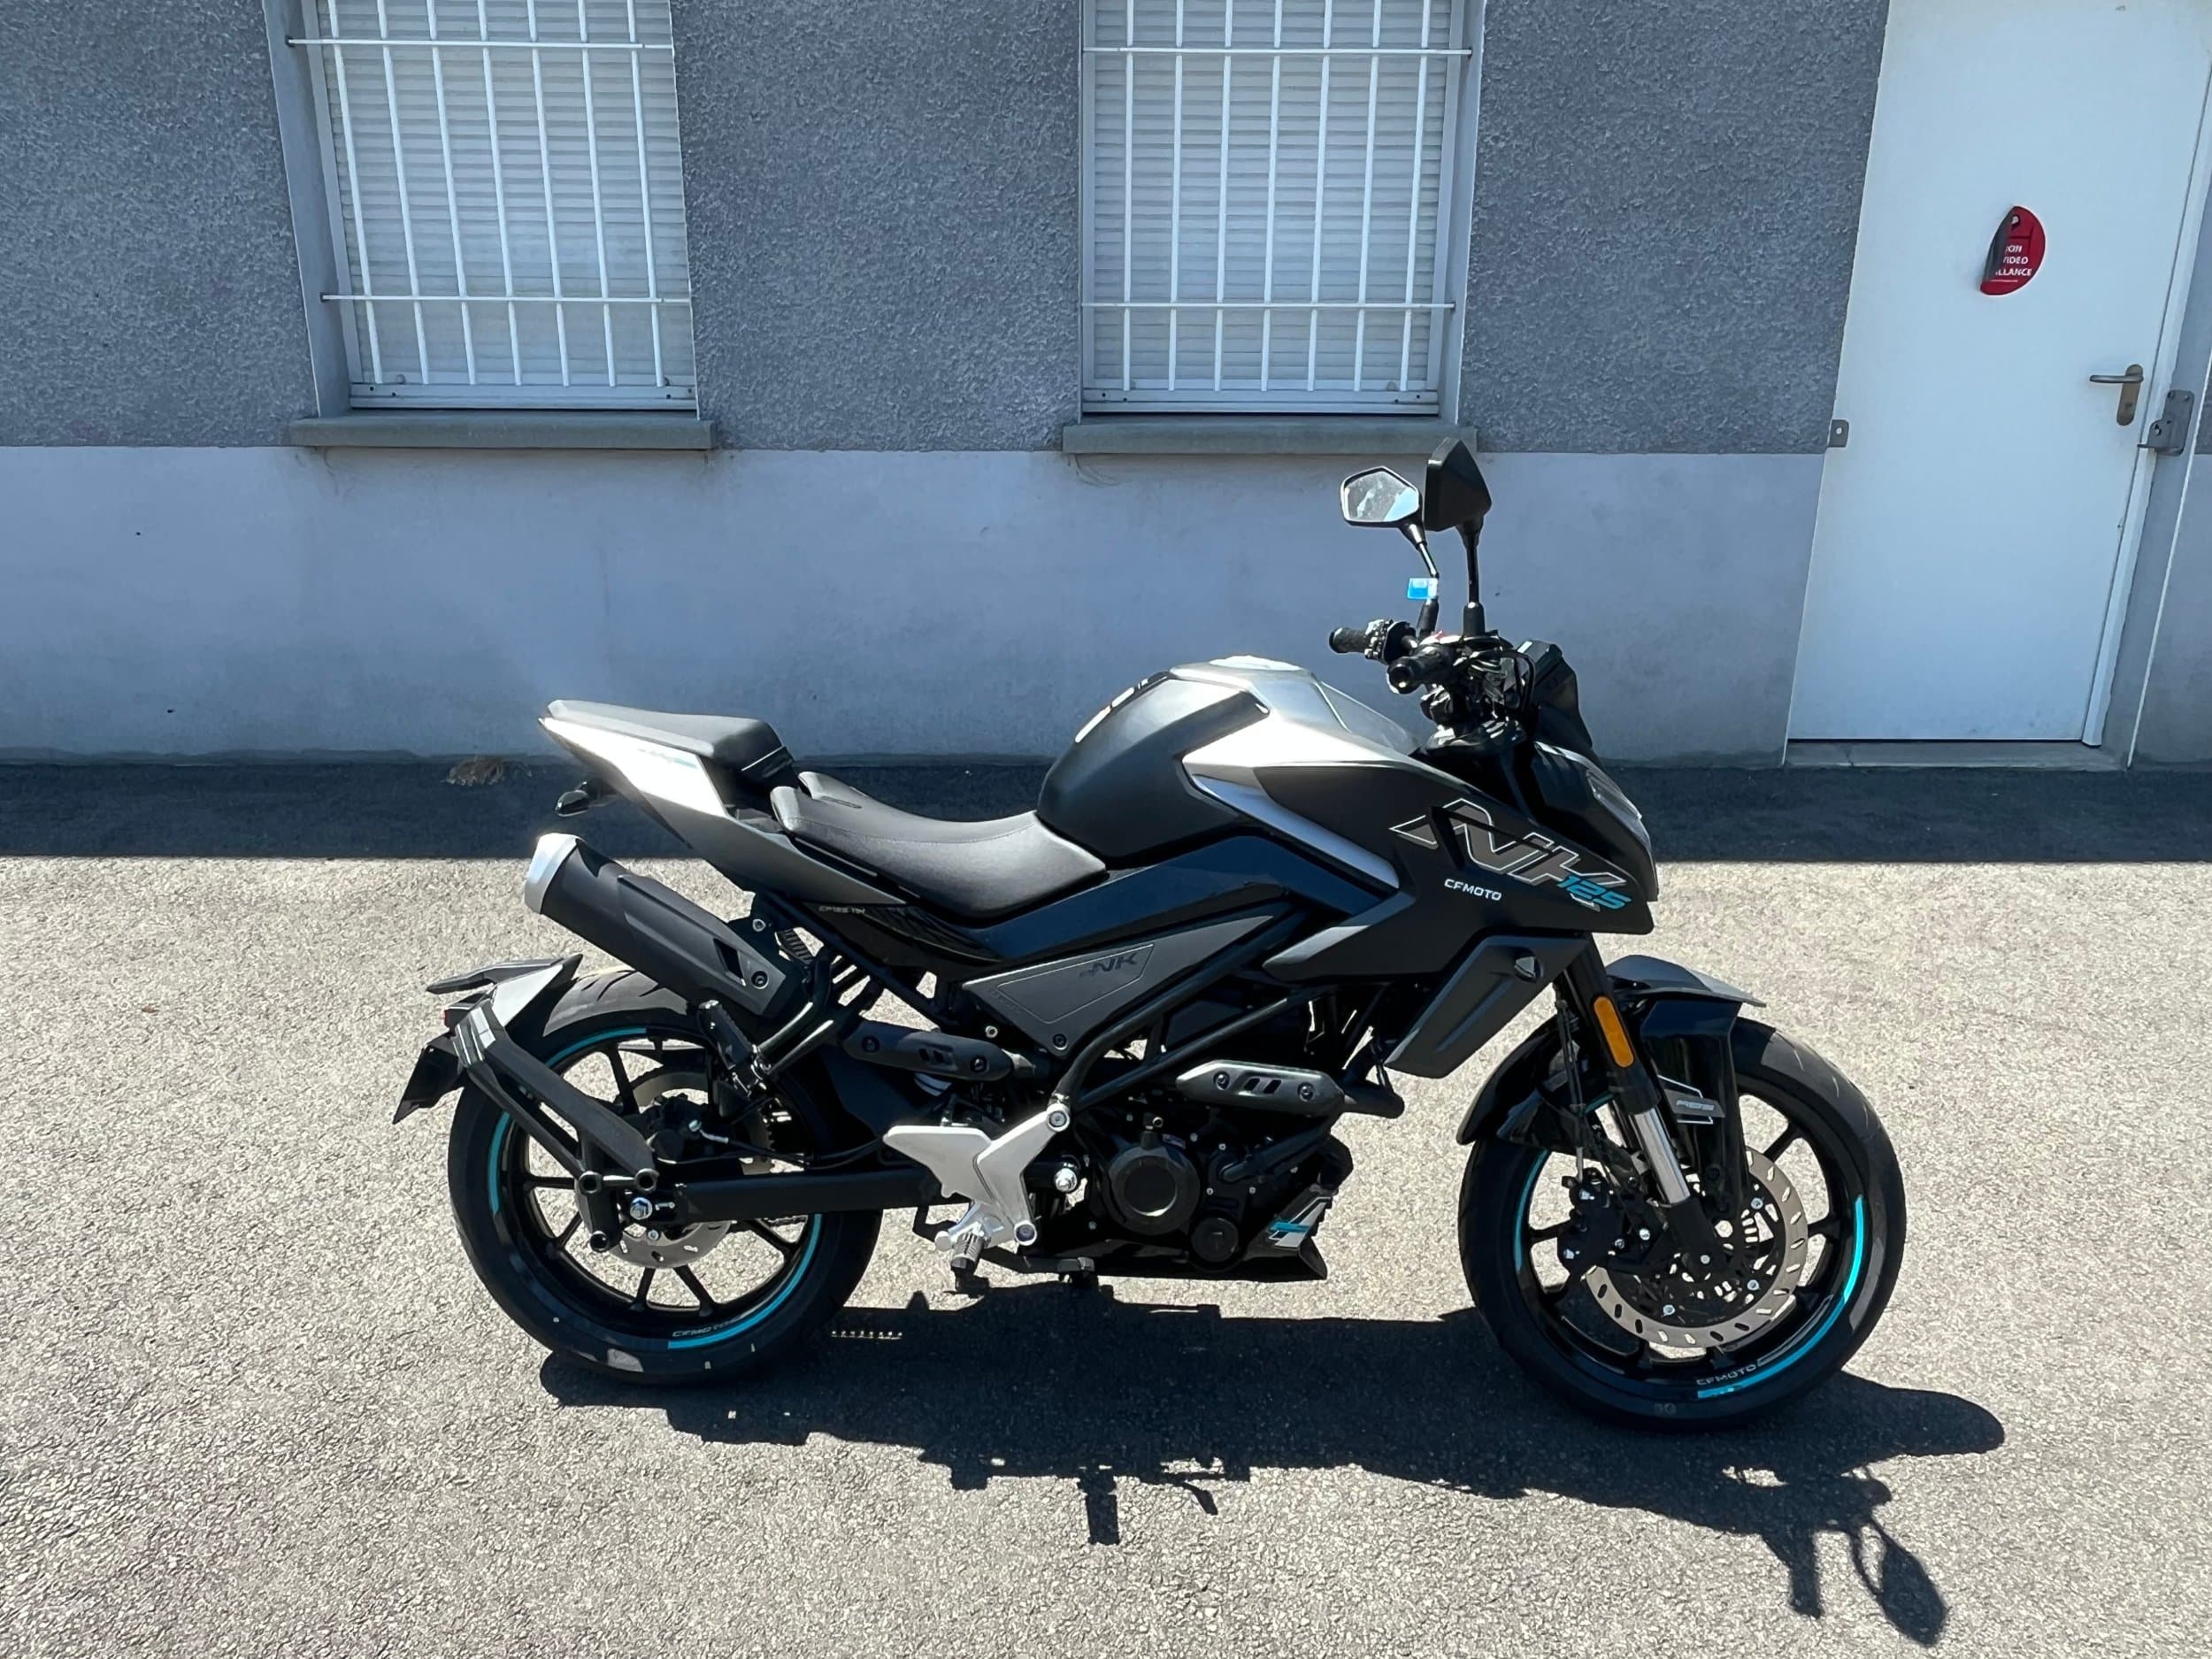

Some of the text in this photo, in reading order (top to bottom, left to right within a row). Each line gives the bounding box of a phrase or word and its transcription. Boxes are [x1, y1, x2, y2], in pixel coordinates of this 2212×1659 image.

[1444, 879, 1502, 901] CFMOTO
[1557, 875, 1632, 910] 125
[1695, 1364, 1756, 1386] CFMOTO
